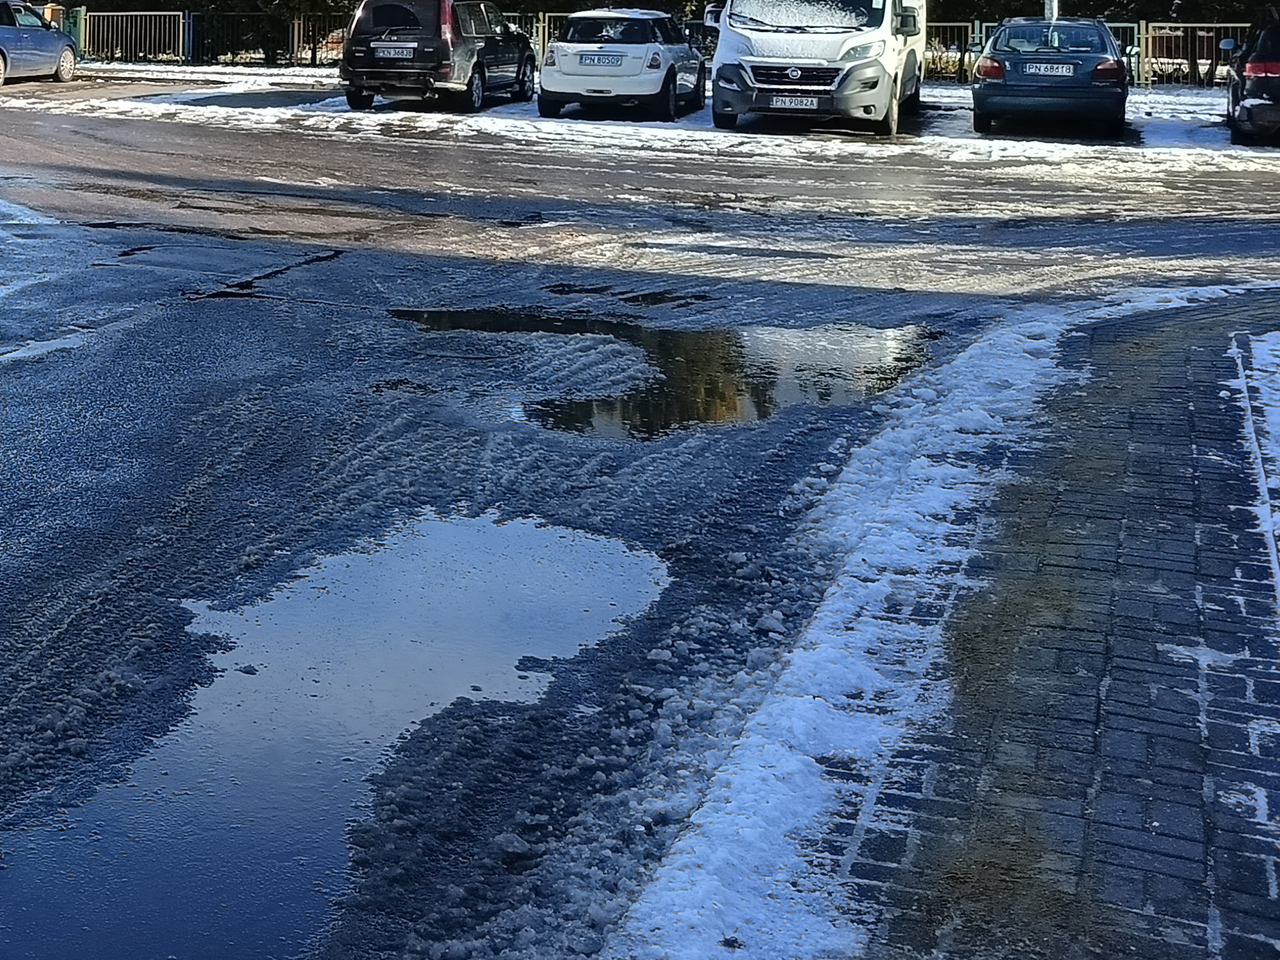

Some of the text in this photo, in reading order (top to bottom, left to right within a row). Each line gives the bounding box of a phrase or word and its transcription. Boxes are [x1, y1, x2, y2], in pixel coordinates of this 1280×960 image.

[584, 56, 596, 64] PN
[1028, 64, 1042, 73] PN
[775, 97, 815, 107] PN 9082A
